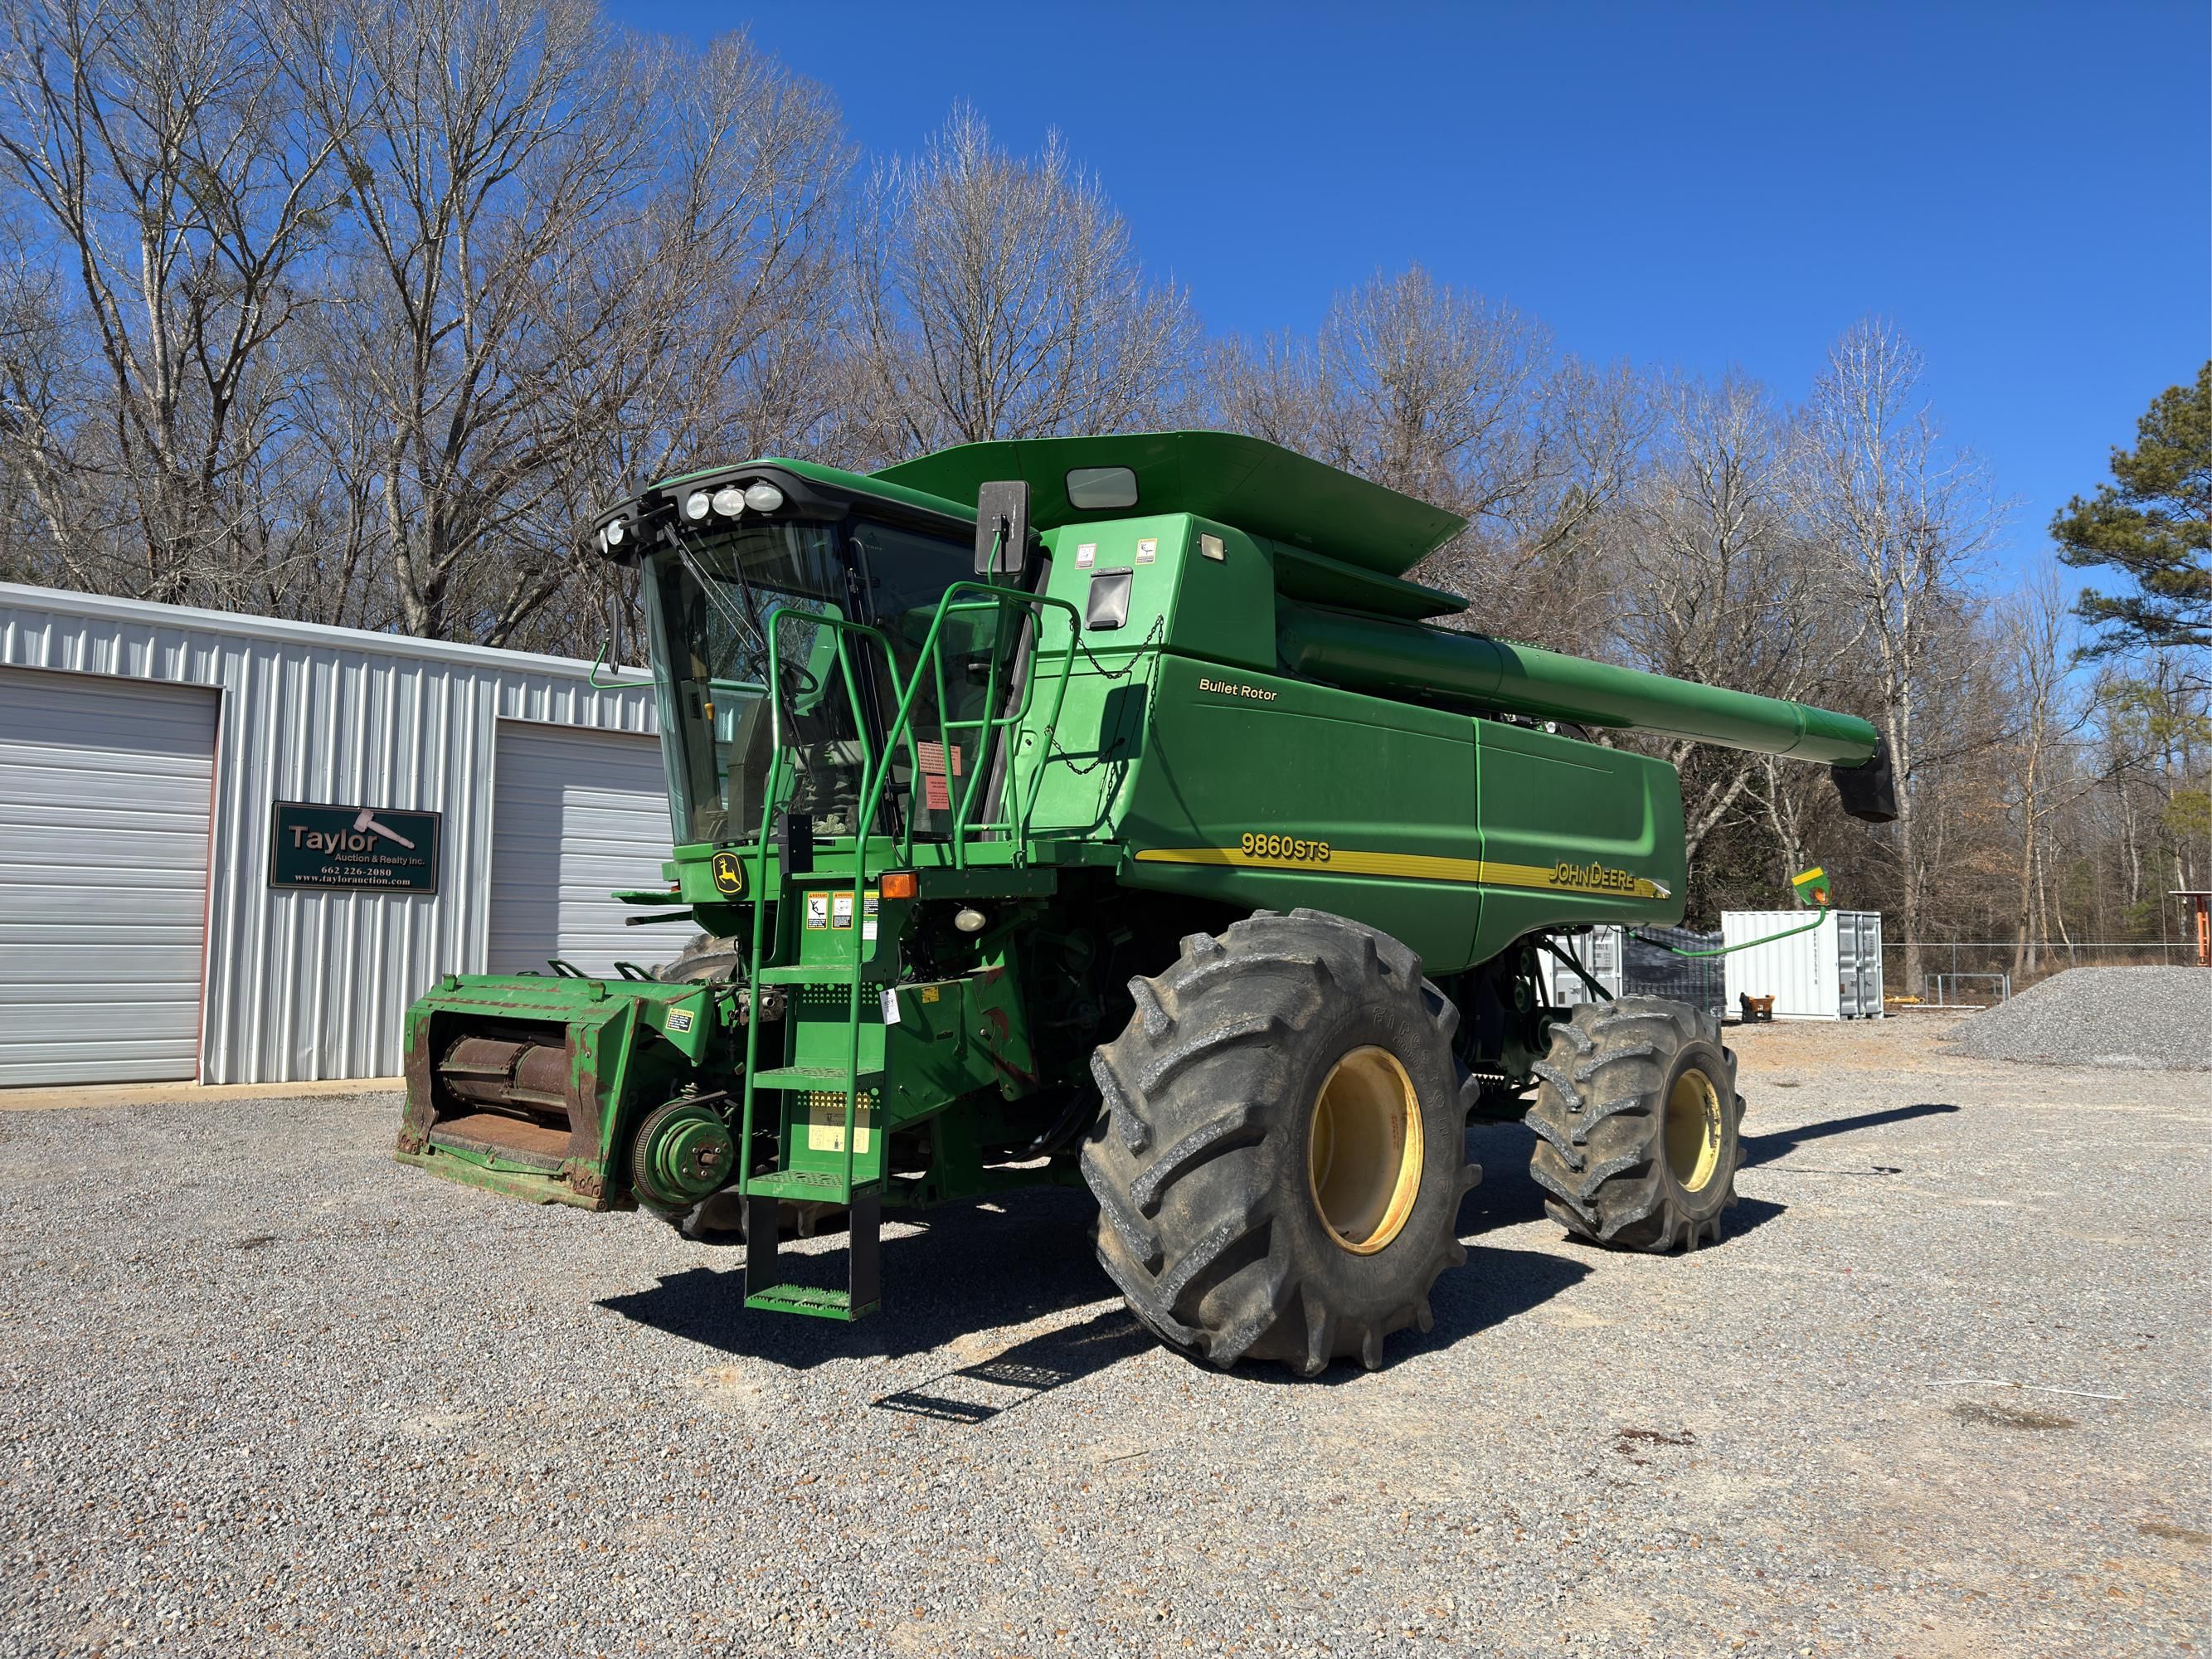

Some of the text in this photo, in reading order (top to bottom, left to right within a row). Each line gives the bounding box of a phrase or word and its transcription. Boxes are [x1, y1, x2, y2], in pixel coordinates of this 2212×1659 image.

[1198, 678, 1278, 702] Bullet Rotor
[289, 825, 378, 855] Taylor
[1242, 832, 1330, 862] 9860STS
[321, 866, 392, 877] 662 226-2080
[334, 853, 425, 866] Auction & Realty Inc.
[294, 874, 411, 886] www.taylorauction.com
[1548, 861, 1590, 885] JOHN
